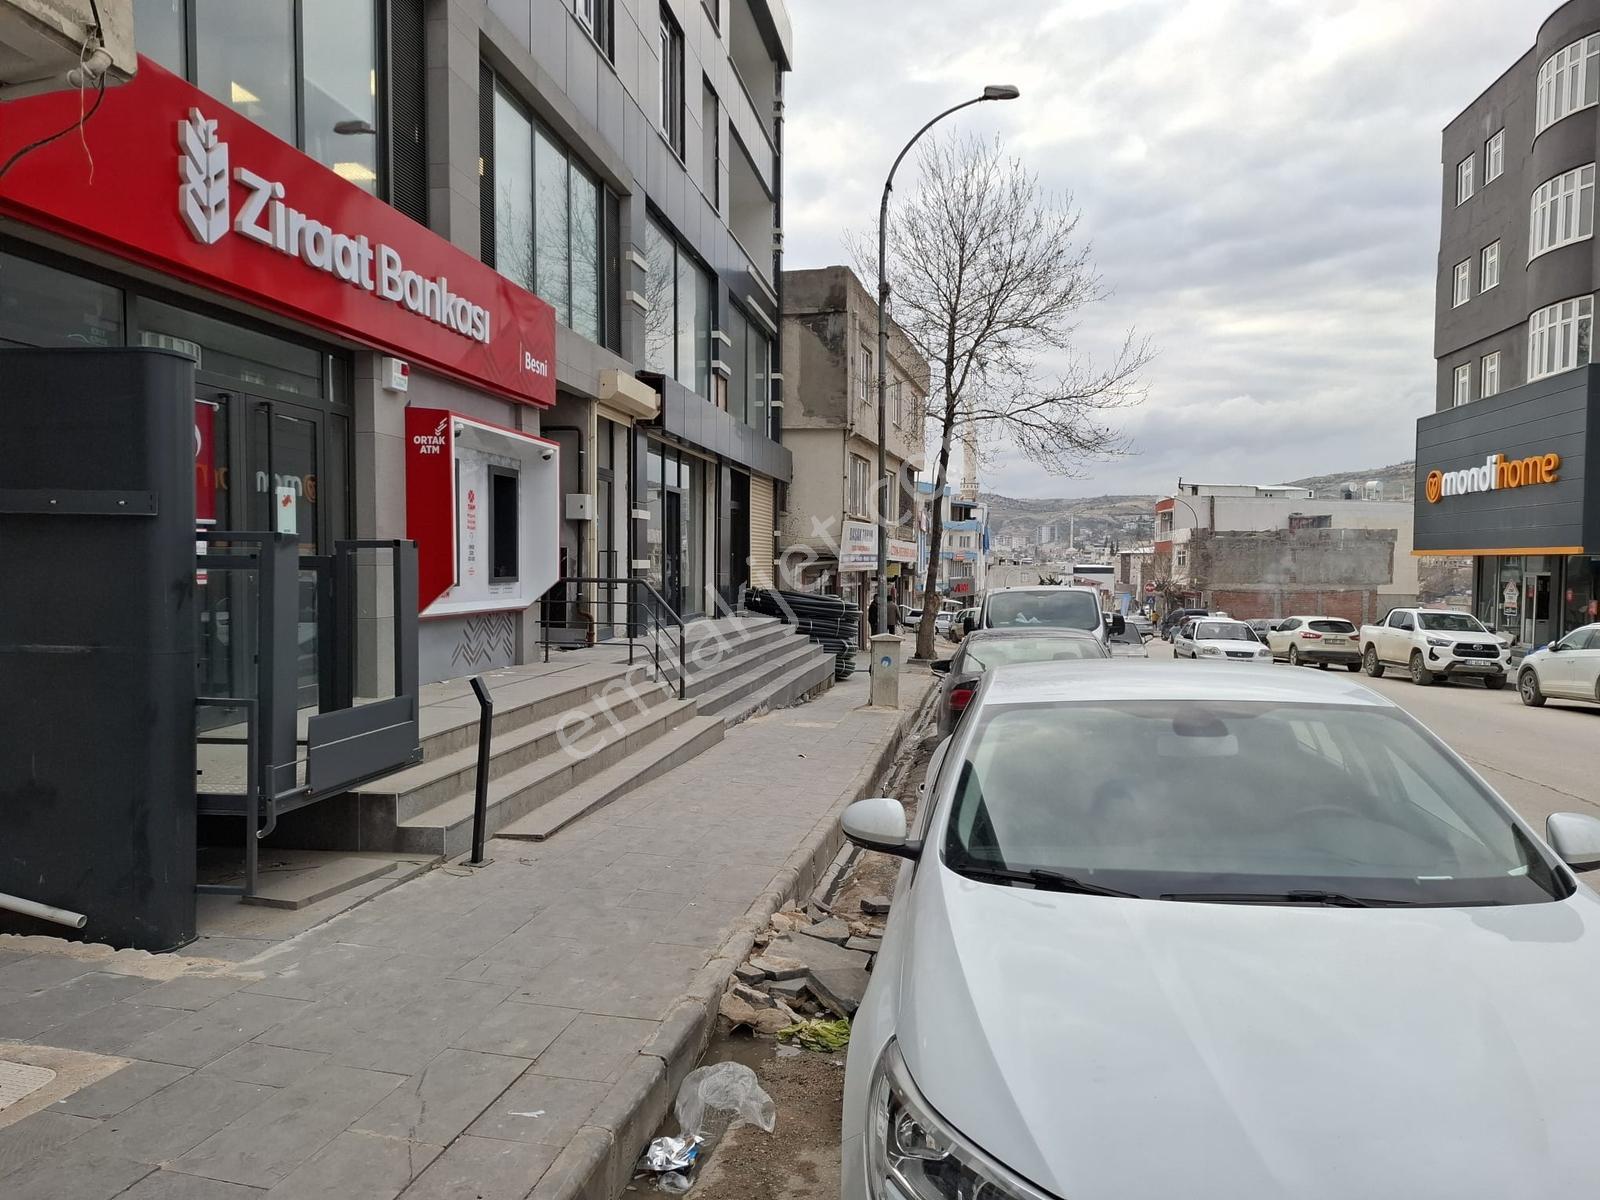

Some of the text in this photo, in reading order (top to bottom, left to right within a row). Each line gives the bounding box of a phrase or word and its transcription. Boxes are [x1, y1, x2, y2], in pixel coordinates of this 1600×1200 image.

[233, 166, 490, 344] Ziraat Bankası
[525, 351, 548, 377] Besni
[413, 435, 446, 445] ORTAK
[419, 445, 440, 454] ATM
[1441, 453, 1560, 497] mondihome
